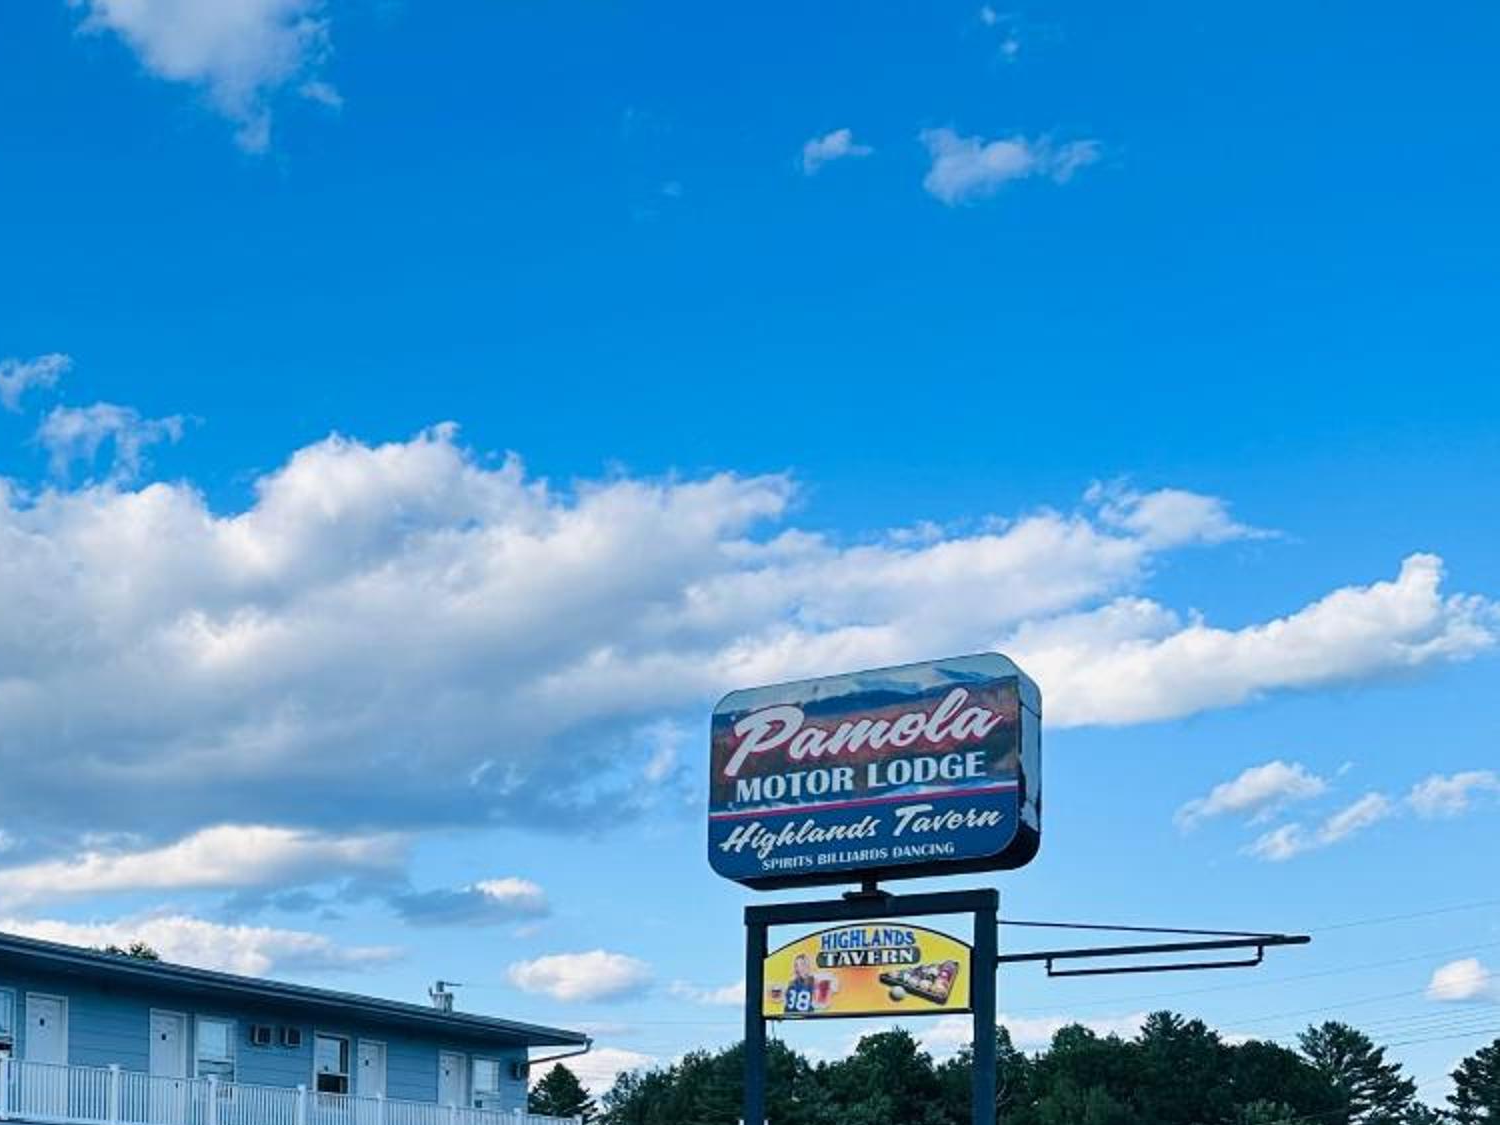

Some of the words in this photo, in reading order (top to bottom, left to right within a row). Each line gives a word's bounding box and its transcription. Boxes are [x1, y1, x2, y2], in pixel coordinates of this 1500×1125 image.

[723, 687, 1002, 777] Pamola
[735, 766, 854, 803] MOTOR
[867, 751, 987, 788] LODGE
[719, 815, 881, 859] Highlands
[892, 804, 1003, 838] Tavern
[761, 854, 814, 871] SPIRITS
[817, 847, 889, 866] BILLIARDS
[893, 842, 956, 860] DANCING
[821, 928, 916, 950] HIGHLANDS
[824, 949, 914, 967] TAVERN
